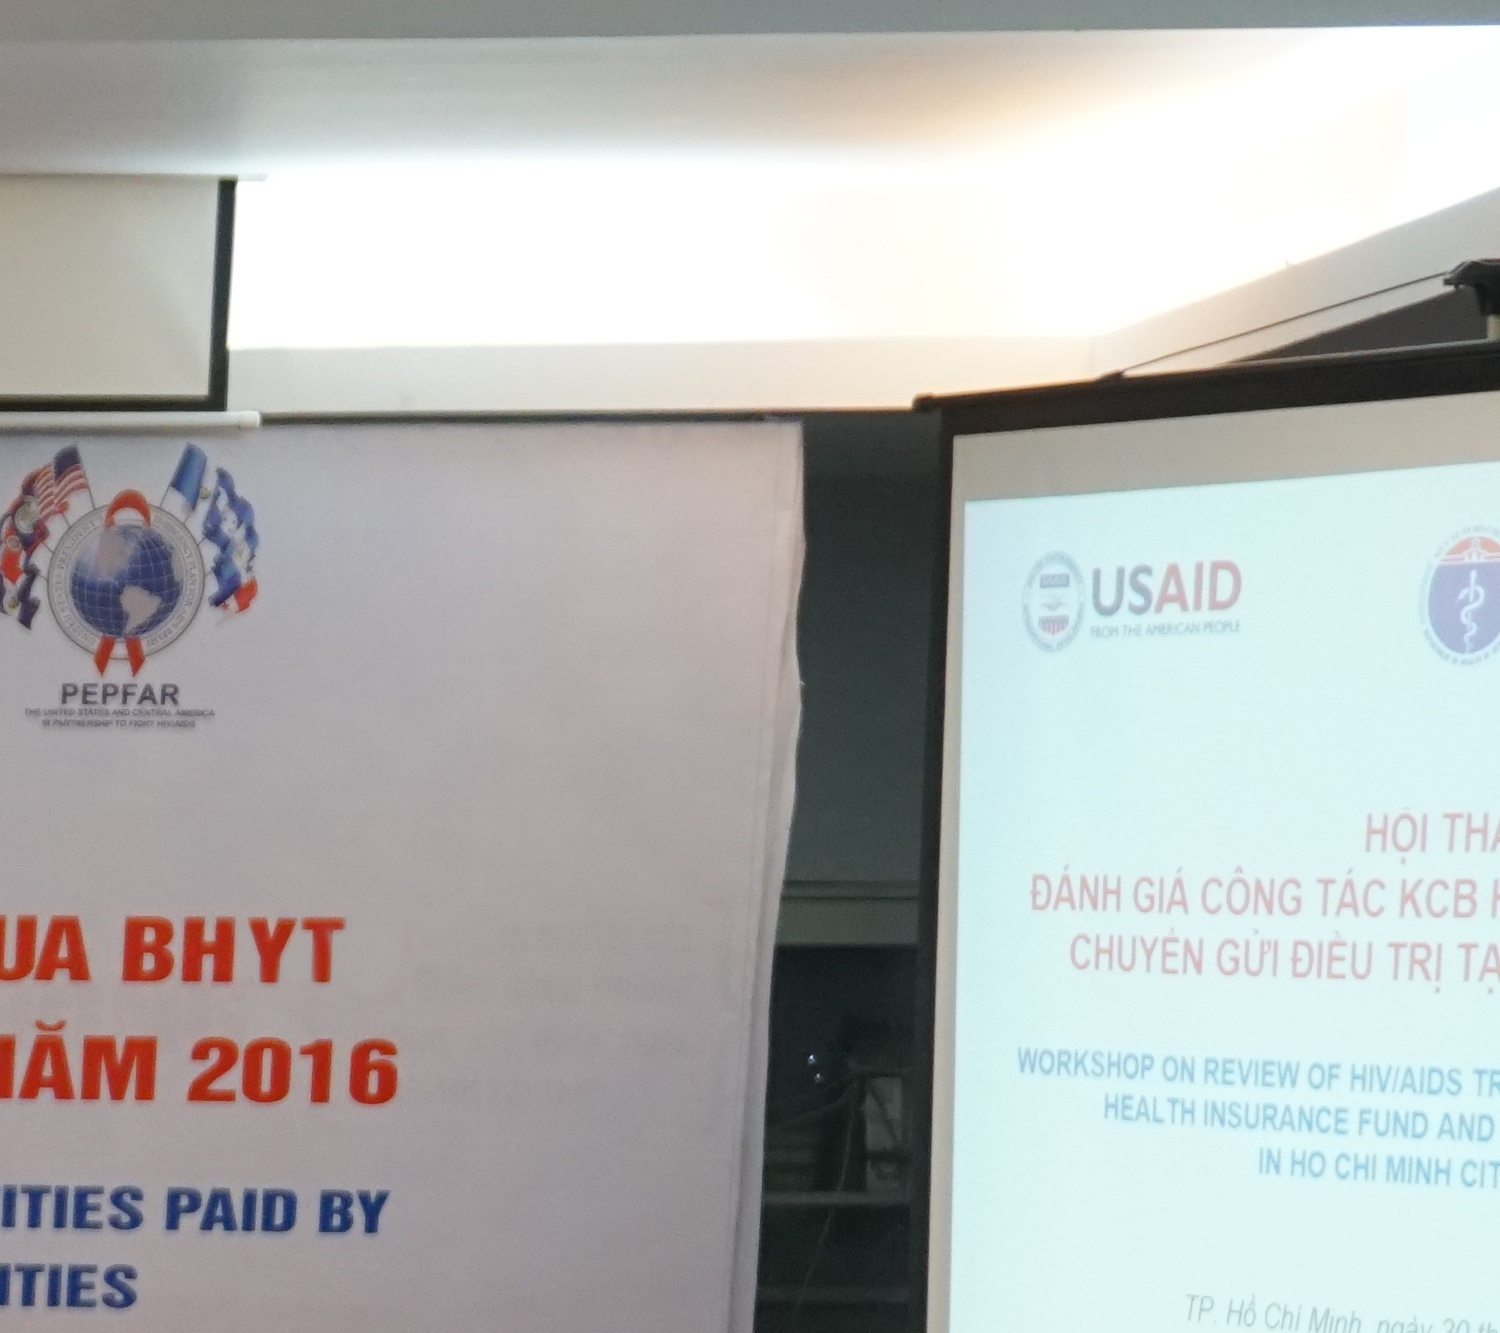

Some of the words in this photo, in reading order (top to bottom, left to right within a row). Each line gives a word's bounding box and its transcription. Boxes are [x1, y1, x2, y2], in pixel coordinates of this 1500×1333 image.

[1092, 561, 1242, 618] USAID
[1088, 622, 1121, 638] FROM
[1122, 621, 1142, 637] THE
[1145, 620, 1201, 636] AMERICAN
[1203, 618, 1242, 634] PEOPLE
[61, 684, 178, 705] PEPFAR
[1365, 813, 1428, 864] HỘI
[1030, 866, 1121, 911] ĐÁNH
[1133, 868, 1189, 914] GIÁ
[1201, 866, 1302, 916] CÔNG
[1317, 870, 1386, 918] TÁC
[1400, 878, 1477, 918] KCB
[122, 917, 345, 984] BHYT
[1070, 934, 1203, 976] CHUYỂN
[1216, 930, 1279, 977] GỬI
[1290, 940, 1373, 980] ĐIỀU
[1387, 942, 1442, 993] TRỊ
[187, 1037, 398, 1106] 2016
[1018, 1047, 1155, 1080] WORKSHOP
[1162, 1055, 1195, 1083] ON
[1204, 1057, 1300, 1088] REVIEW
[1307, 1062, 1341, 1090] OF
[1350, 1064, 1462, 1096] HIV/AIDS
[1104, 1094, 1195, 1125] HEALTH
[1204, 1101, 1348, 1136] INSURANCE
[1358, 1108, 1429, 1140] FUND
[1437, 1112, 1495, 1143] AND
[1259, 1148, 1281, 1175] IN
[1290, 1150, 1326, 1178] HO
[1334, 1152, 1376, 1181] CHI
[1386, 1156, 1451, 1185] MINH
[1458, 1158, 1500, 1188] CIT
[166, 1189, 298, 1233] PAID
[319, 1191, 388, 1234] BY
[1186, 1294, 1217, 1322] TP.
[1264, 1302, 1302, 1331] Chí
